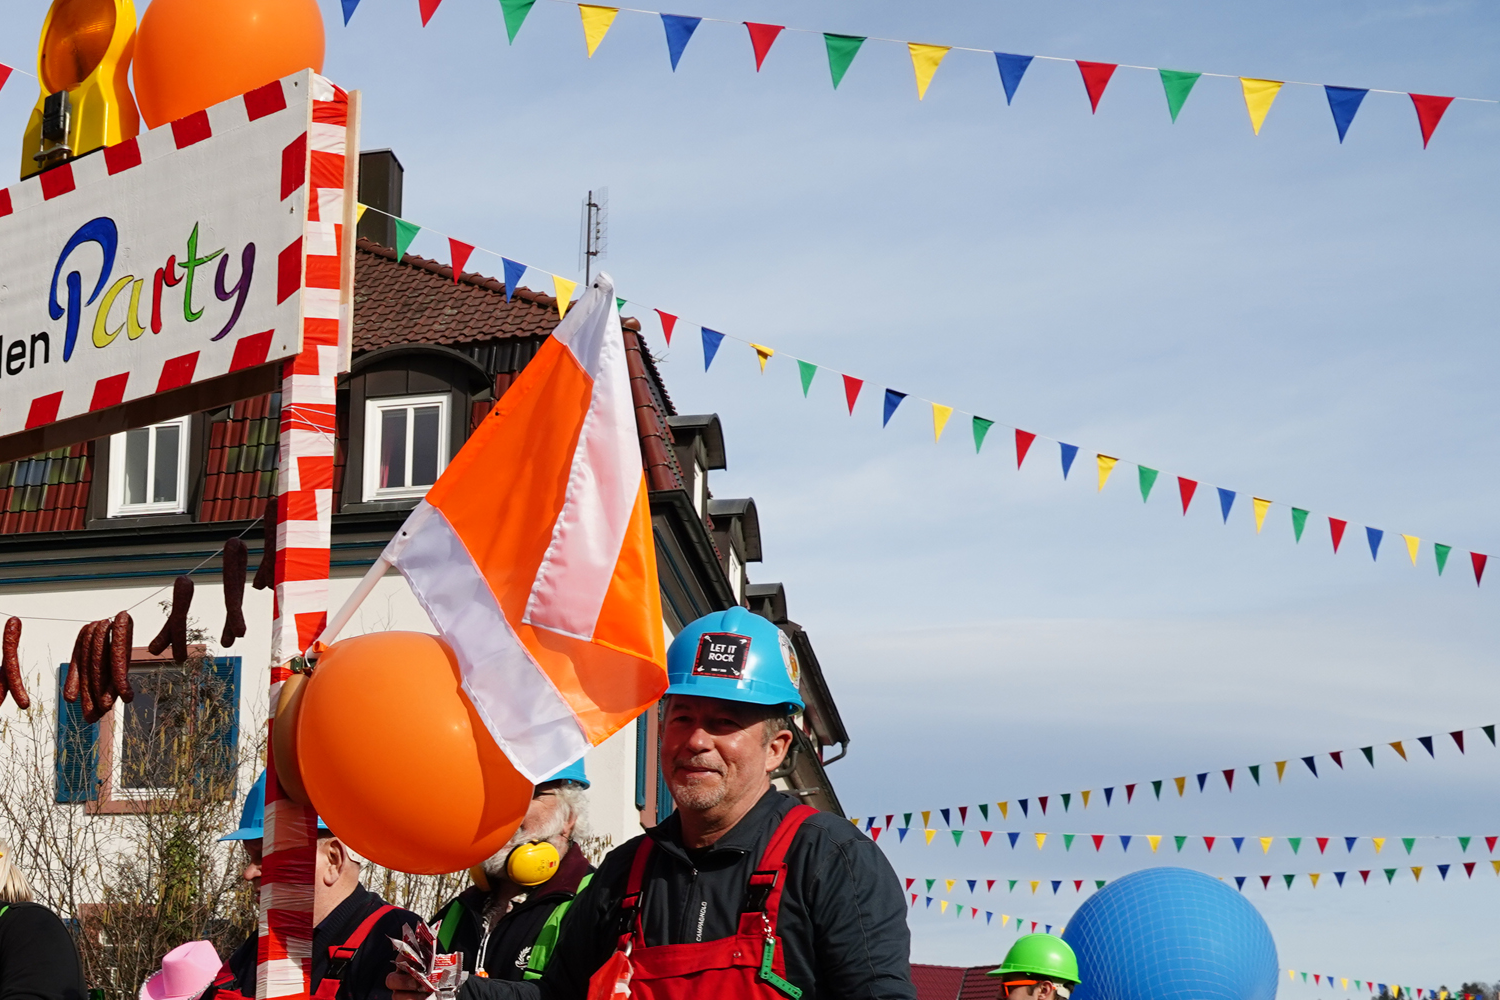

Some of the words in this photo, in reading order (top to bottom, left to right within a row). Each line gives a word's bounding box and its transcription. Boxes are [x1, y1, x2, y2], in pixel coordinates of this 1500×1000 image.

[48, 216, 256, 363] Party
[710, 643, 726, 652] LET
[728, 645, 737, 653] IT
[708, 653, 735, 662] ROCK
